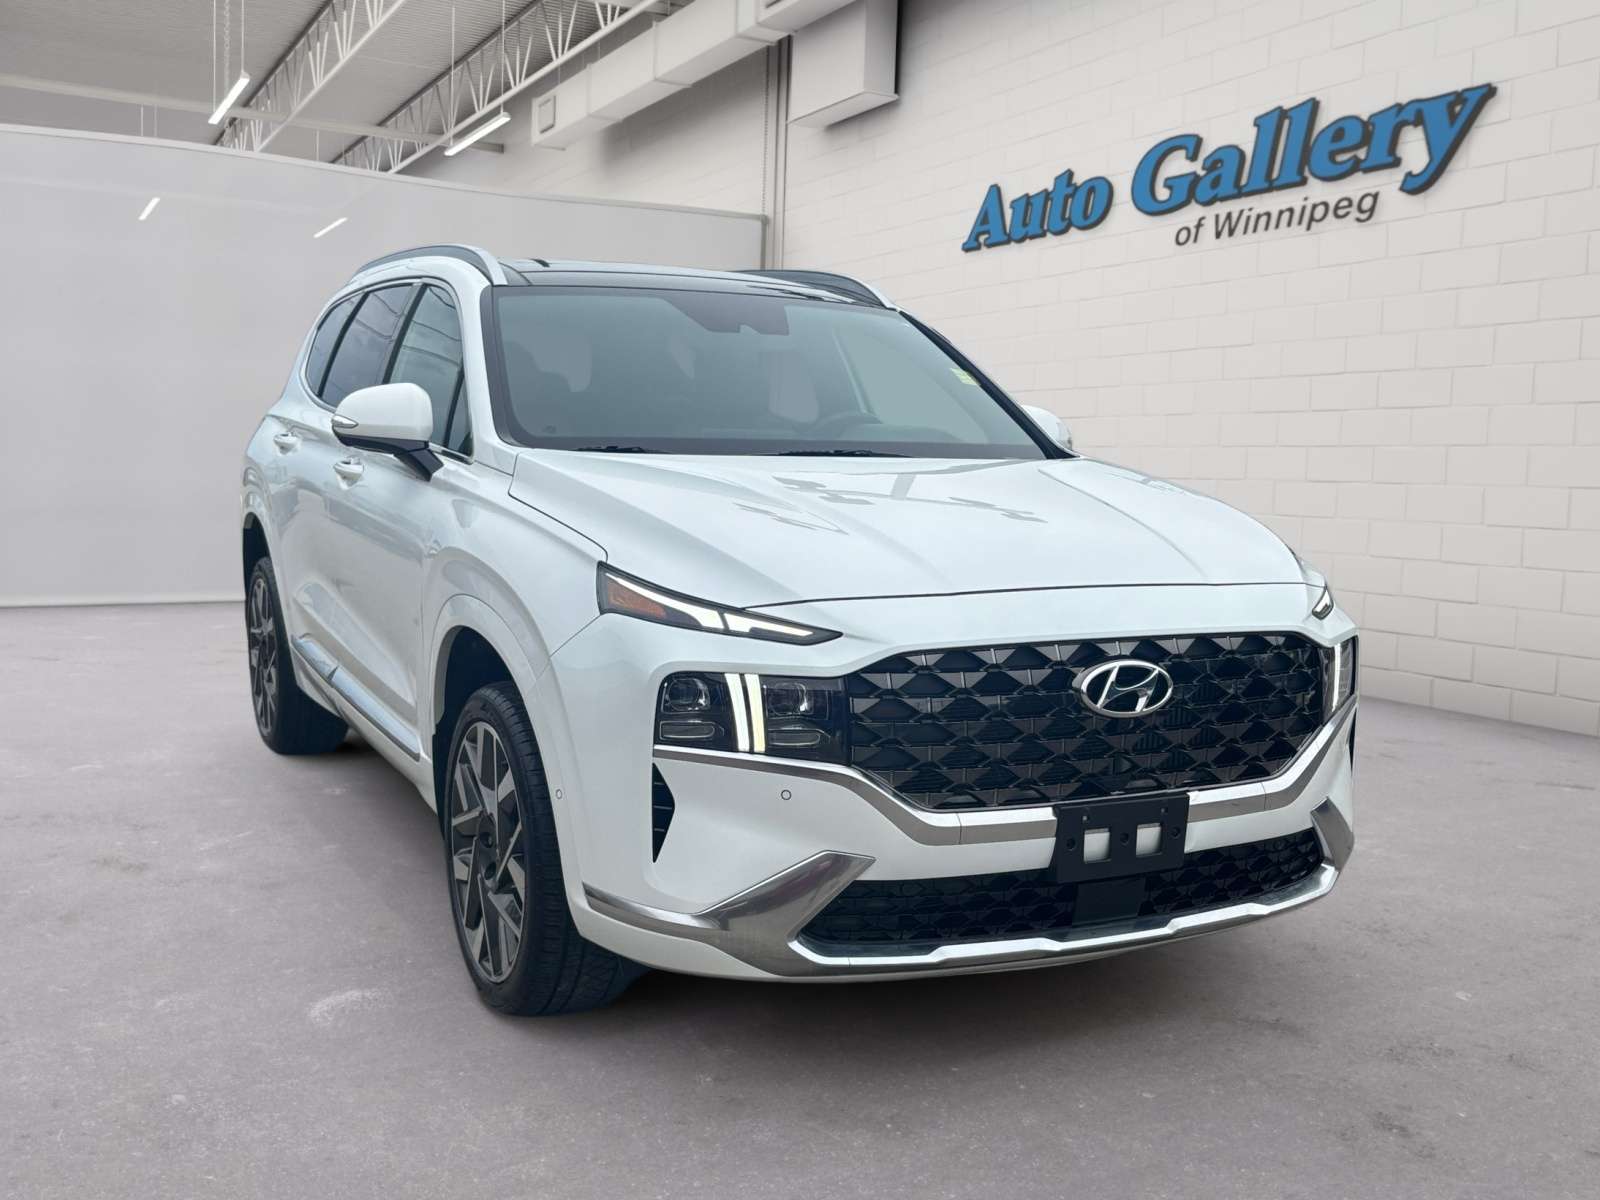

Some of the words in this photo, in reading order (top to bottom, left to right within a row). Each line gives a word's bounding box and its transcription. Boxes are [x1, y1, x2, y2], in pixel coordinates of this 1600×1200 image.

[962, 168, 1114, 252] Auto
[1131, 82, 1498, 216] Gallery
[1174, 221, 1204, 246] of
[1213, 191, 1380, 240] Winnipeg
